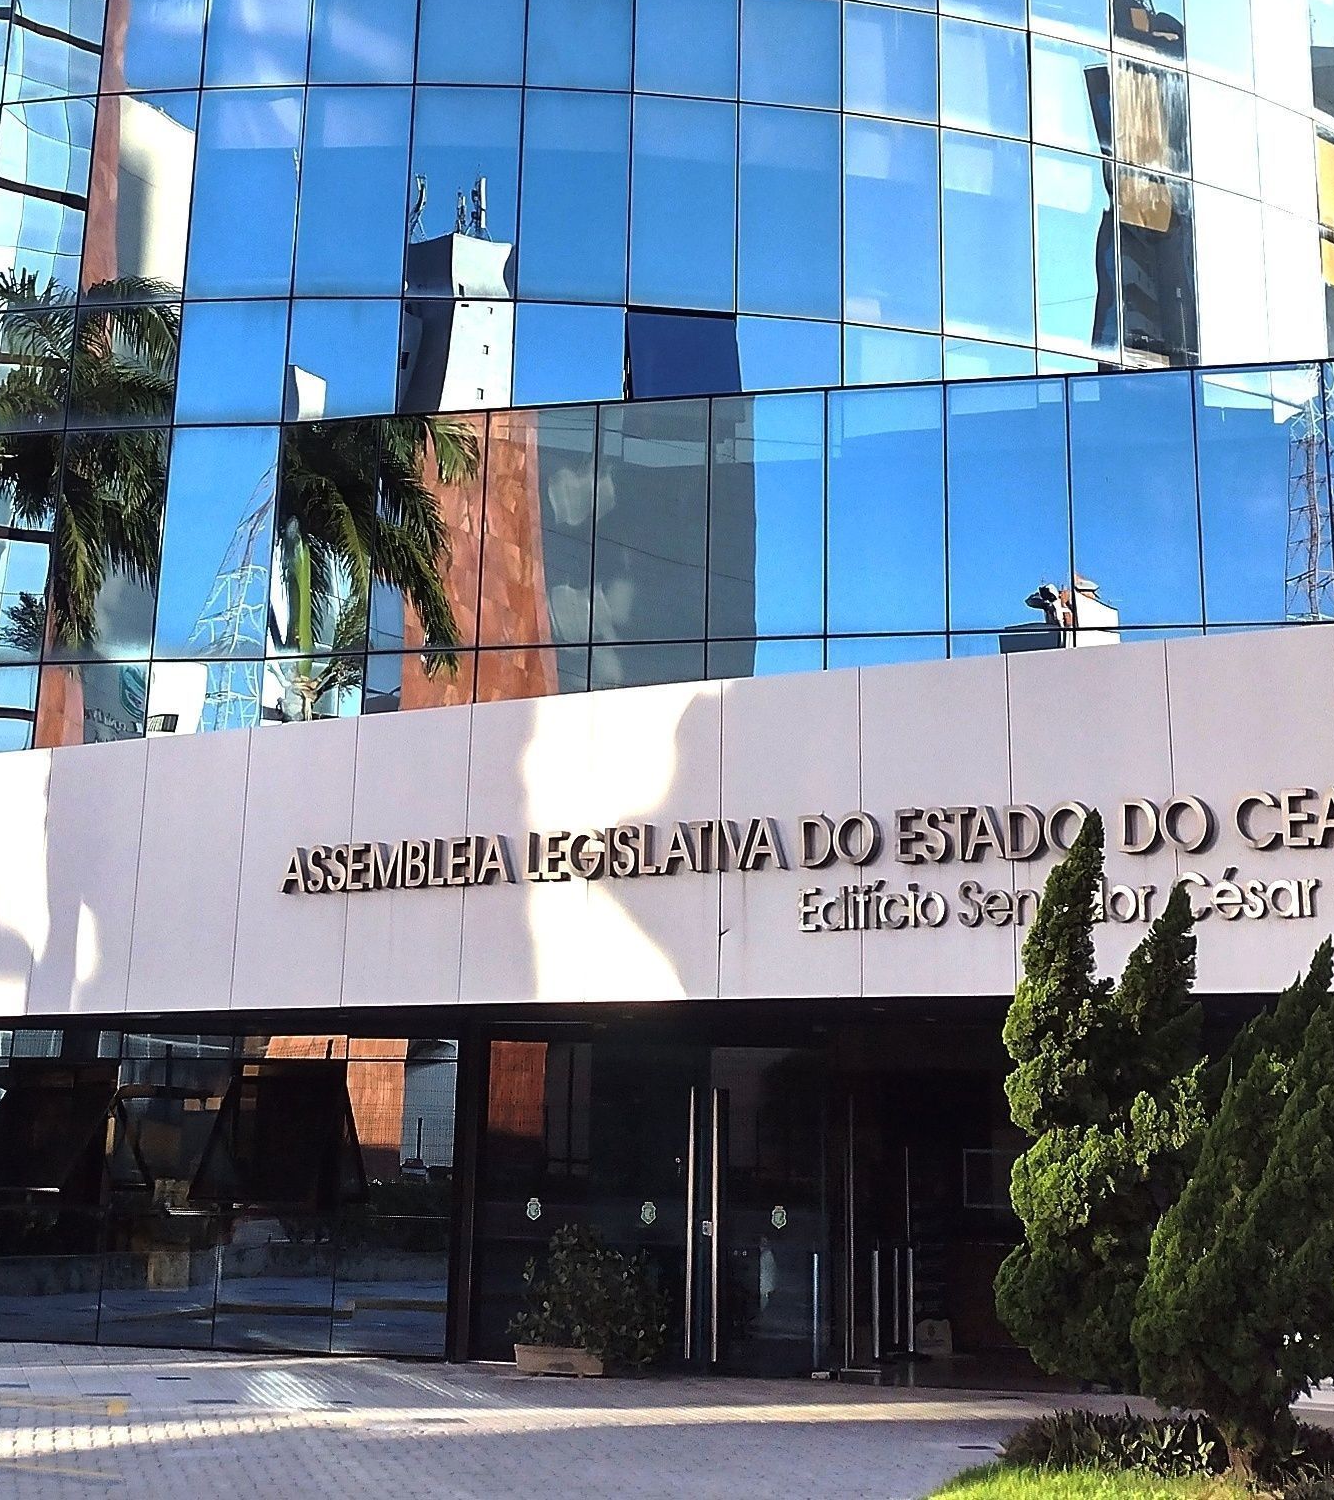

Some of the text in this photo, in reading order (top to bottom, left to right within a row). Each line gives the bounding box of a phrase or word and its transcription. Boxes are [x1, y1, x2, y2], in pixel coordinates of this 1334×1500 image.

[279, 834, 515, 894] ASSEMBLEIA
[523, 817, 789, 882] LEGISLATIVA
[798, 810, 884, 868] DO
[895, 800, 1091, 864] ESTADO
[1118, 794, 1219, 853] DO
[798, 879, 948, 932] Edifício
